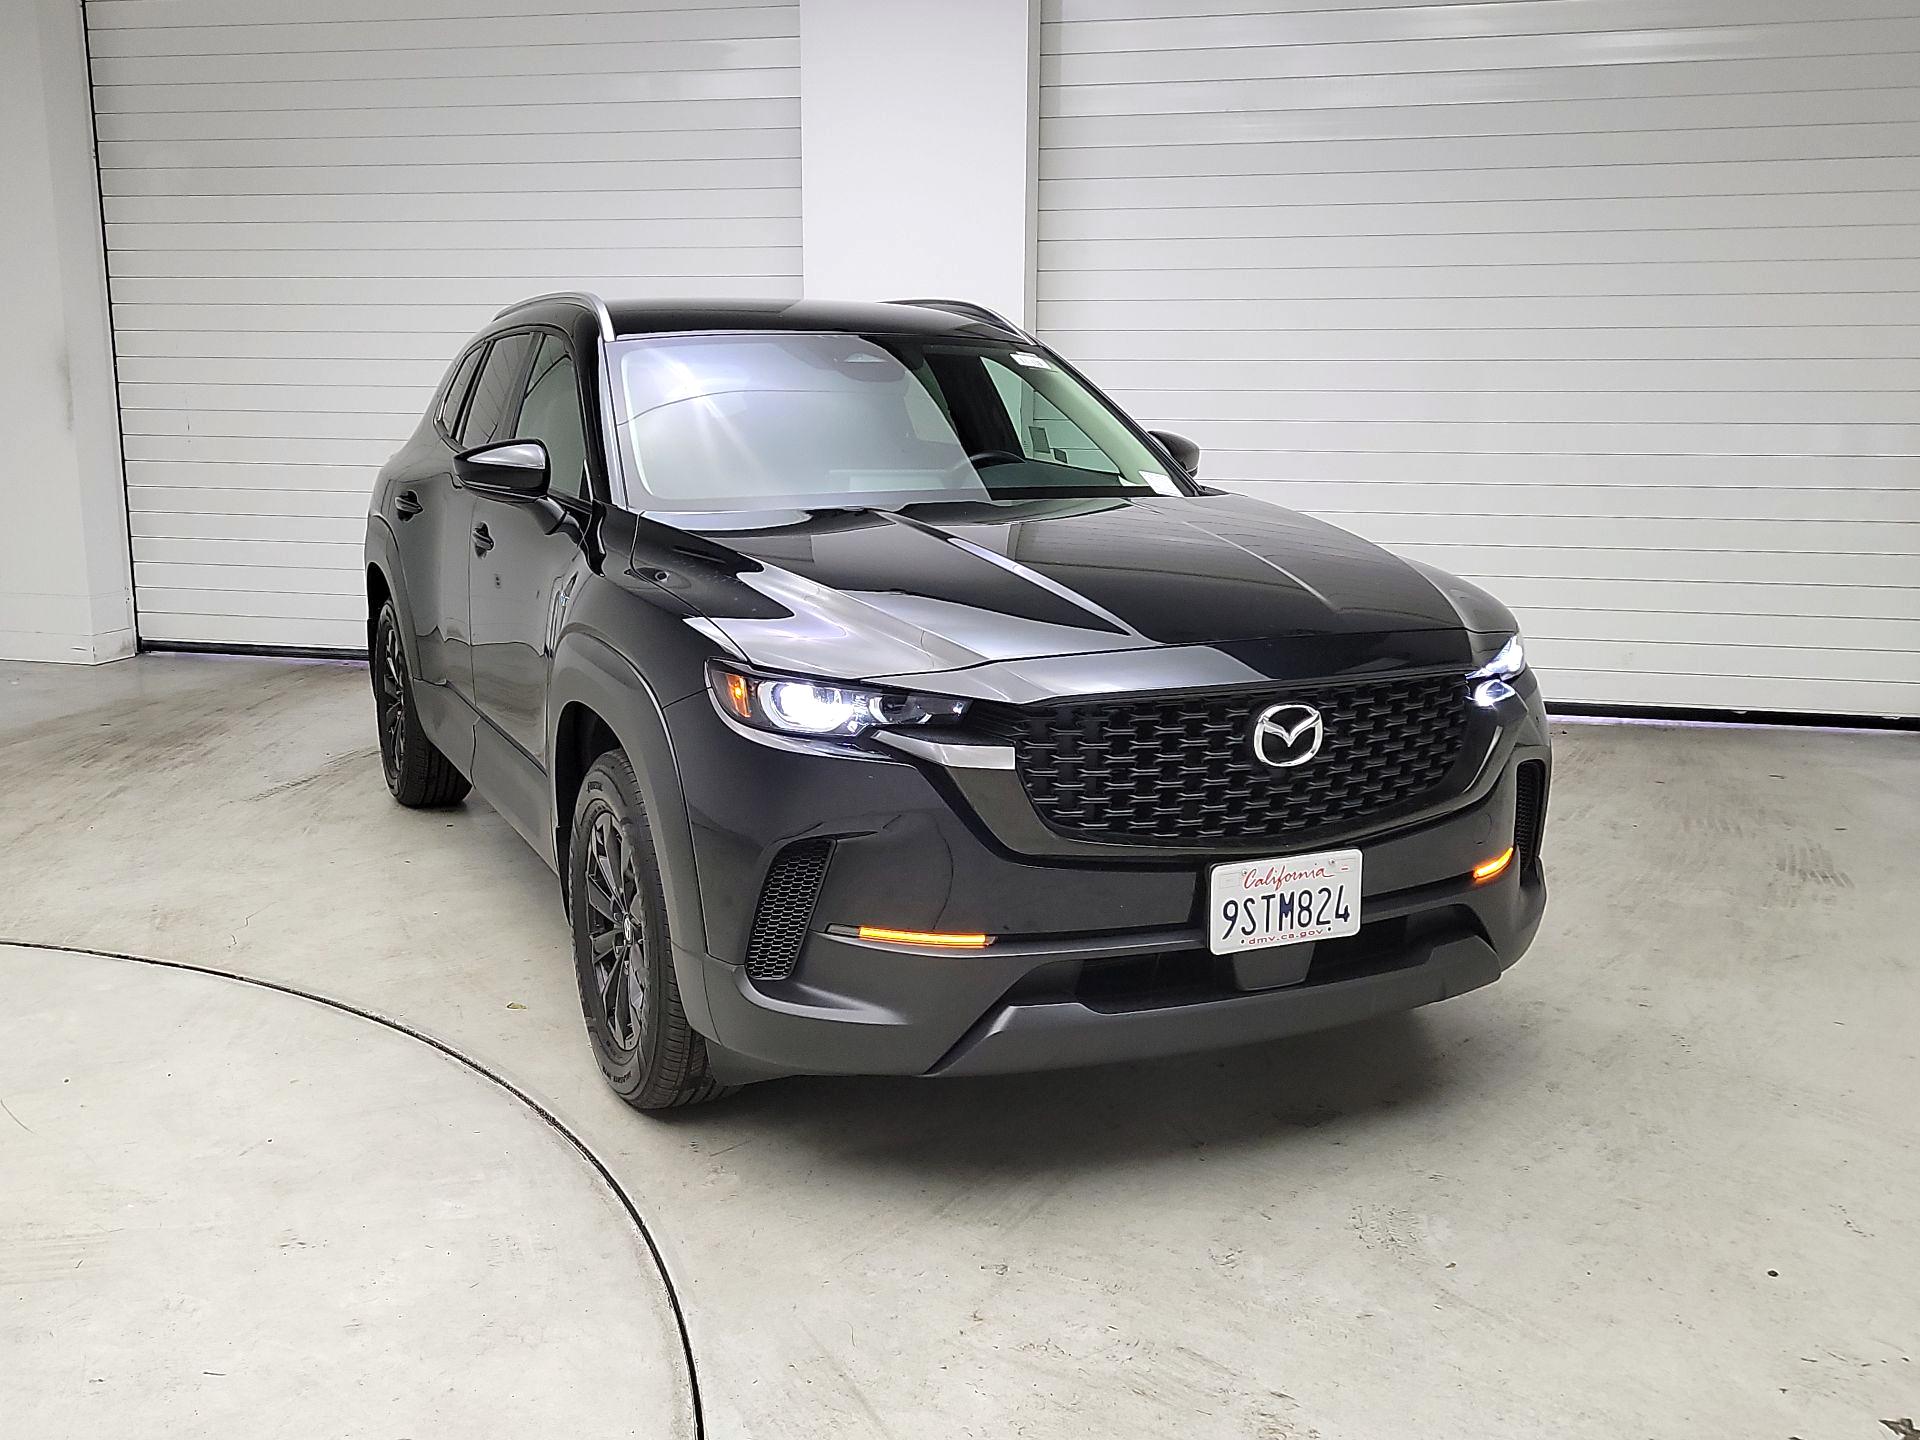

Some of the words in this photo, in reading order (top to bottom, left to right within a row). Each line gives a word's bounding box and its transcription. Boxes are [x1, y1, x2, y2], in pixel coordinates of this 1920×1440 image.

[1243, 864, 1336, 892] California
[1222, 884, 1351, 941] 9STM824
[1248, 928, 1324, 946] dmv.ca.gov
